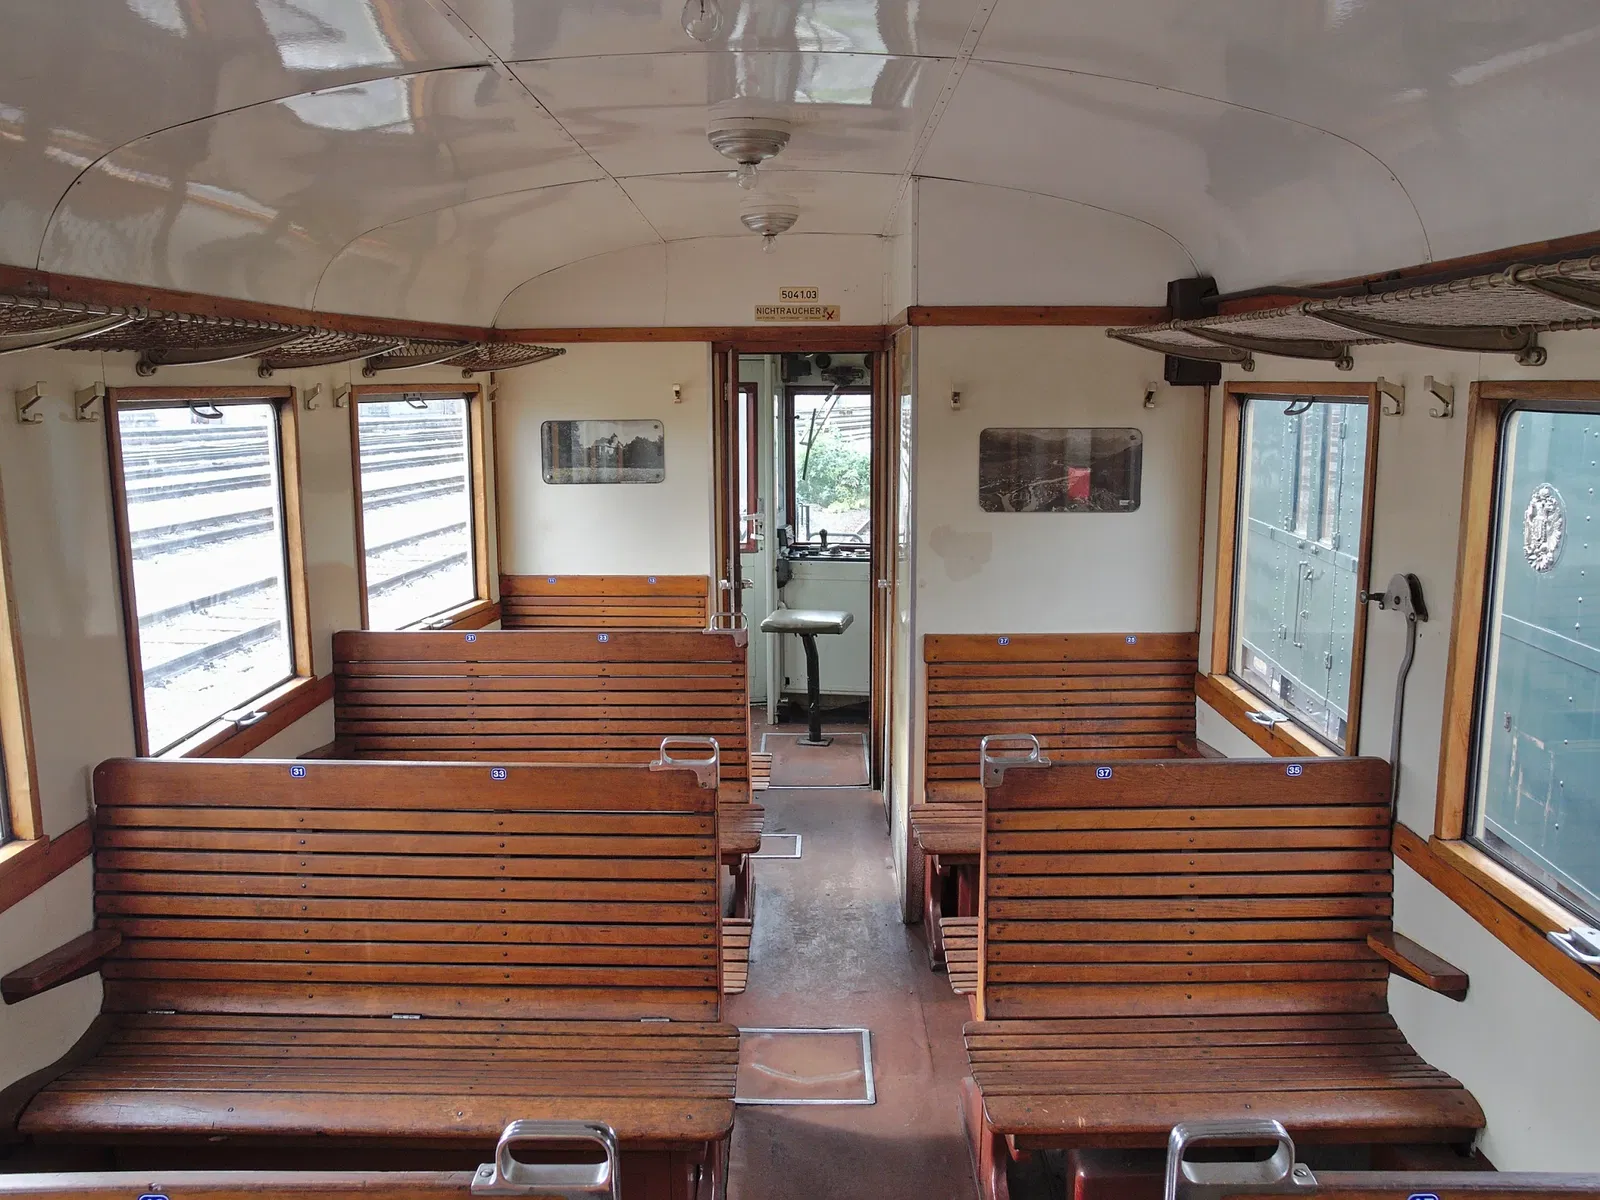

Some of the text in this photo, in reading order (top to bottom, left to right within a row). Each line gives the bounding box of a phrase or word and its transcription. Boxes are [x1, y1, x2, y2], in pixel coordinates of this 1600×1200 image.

[756, 307, 821, 315] NICHTRAUCHER
[293, 768, 303, 776] 31
[493, 770, 504, 778] 33
[1098, 769, 1110, 777] 37
[1288, 766, 1300, 774] 35
